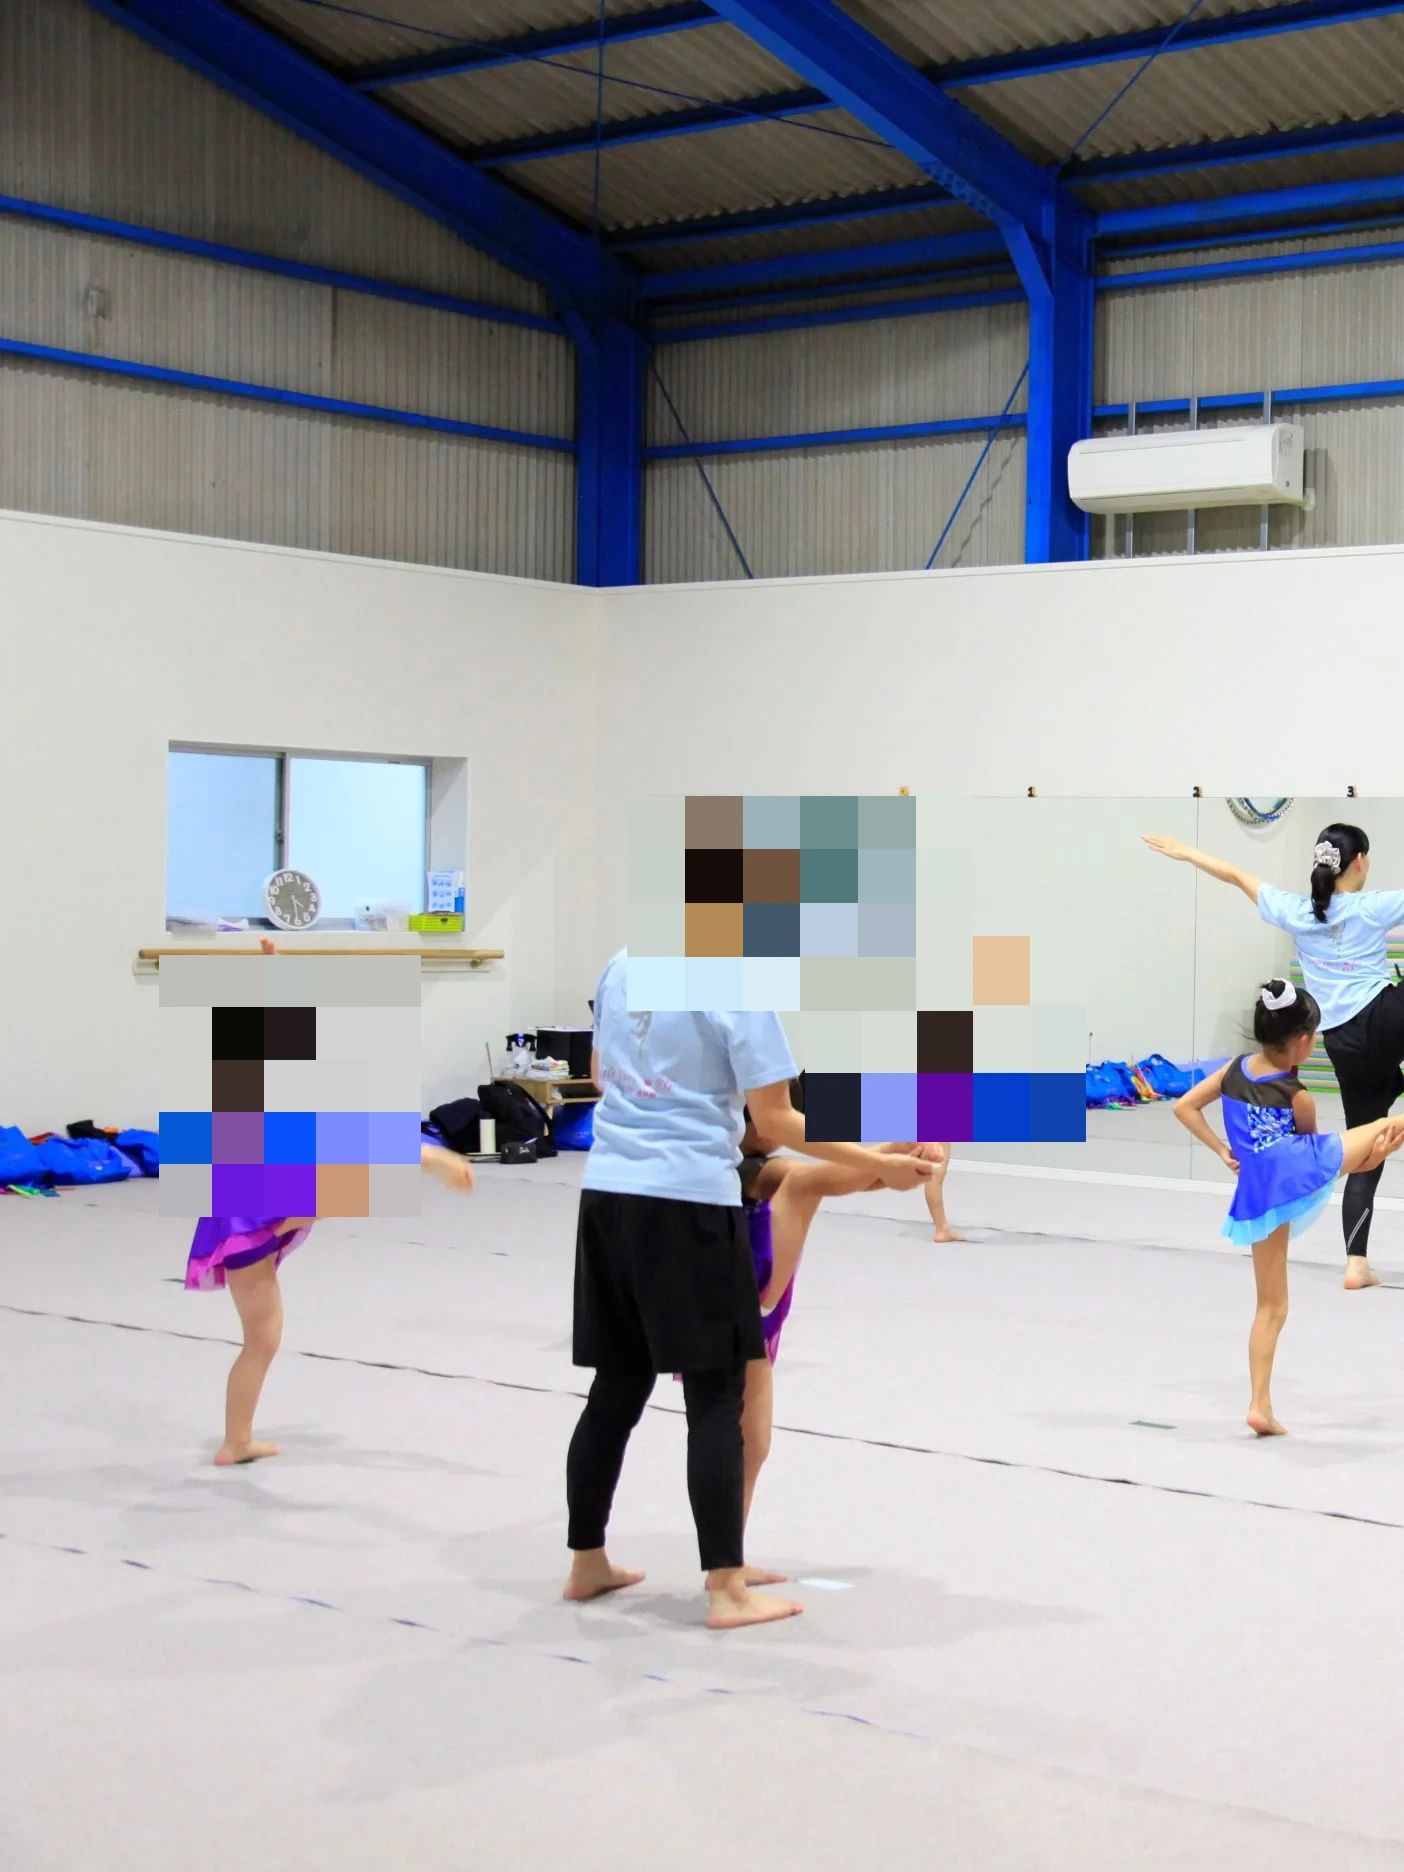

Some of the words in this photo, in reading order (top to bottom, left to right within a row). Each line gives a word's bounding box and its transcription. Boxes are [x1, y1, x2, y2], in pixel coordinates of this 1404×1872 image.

[1027, 786, 1036, 798] 1
[1192, 786, 1202, 798] 2
[1346, 785, 1355, 798] 3
[275, 876, 284, 886] 11
[283, 872, 294, 883] 12
[295, 875, 301, 885] 1
[269, 885, 279, 895] 10
[303, 882, 312, 892] 2
[268, 896, 276, 905] 9
[310, 892, 317, 902] 3
[275, 906, 282, 916] 8
[308, 903, 316, 913] 4
[283, 913, 291, 923] 7
[303, 912, 311, 922] 5
